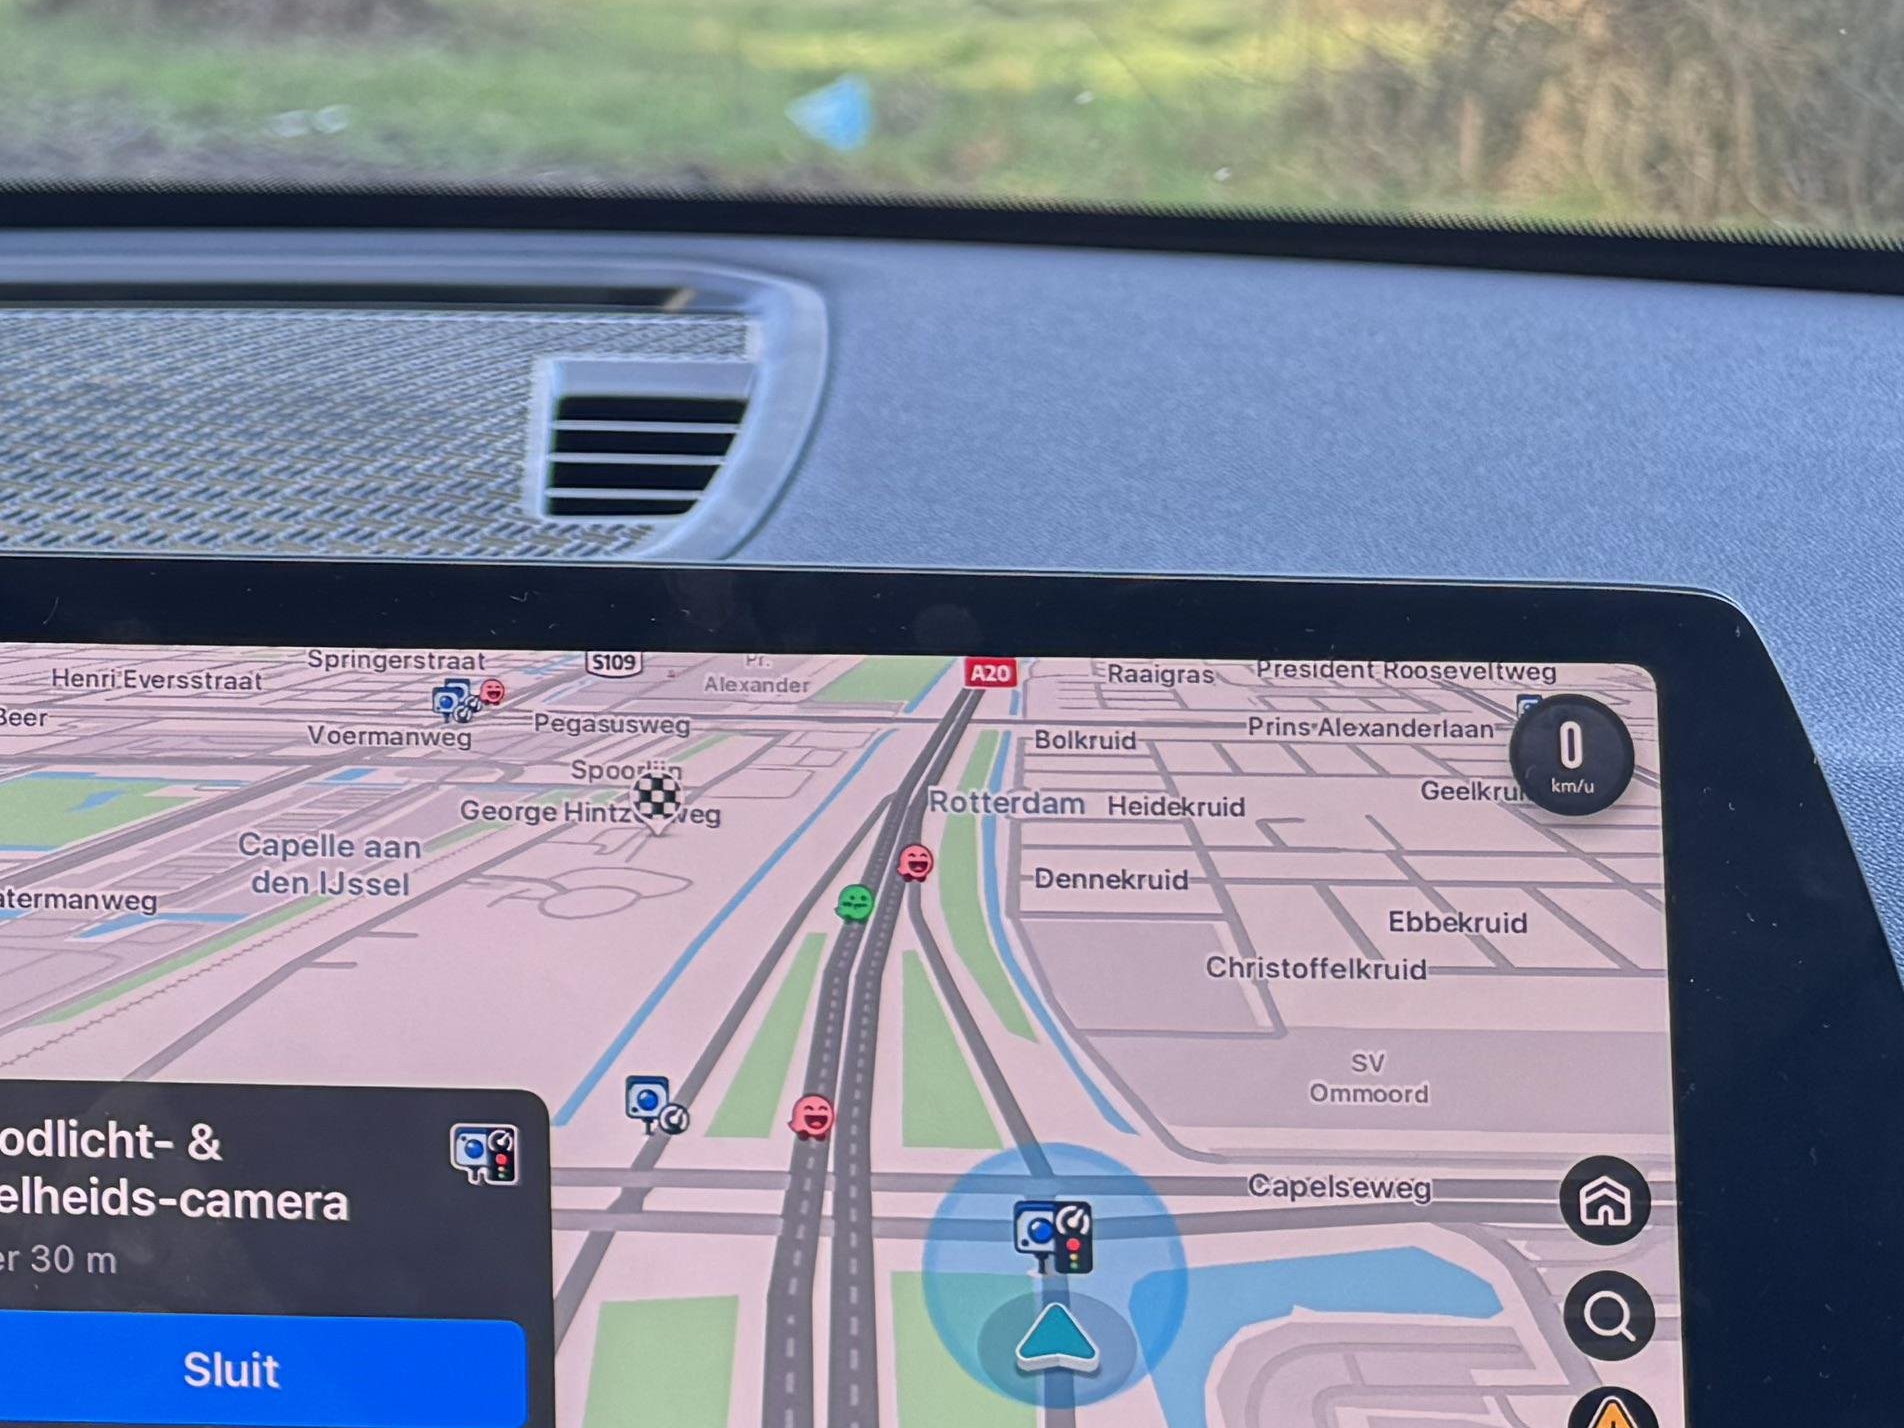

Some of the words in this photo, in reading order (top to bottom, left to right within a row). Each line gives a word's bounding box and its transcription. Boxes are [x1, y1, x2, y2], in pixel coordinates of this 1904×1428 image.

[308, 650, 486, 674] Springerstraat
[592, 654, 636, 671] S109
[971, 664, 1011, 682] A20
[1257, 660, 1375, 679] President
[1383, 661, 1558, 685] Rooseveltweg
[52, 669, 116, 689] Henri
[122, 670, 263, 691] Eversstraat
[704, 676, 811, 693] Alexander
[1108, 664, 1214, 686] Raaigras
[534, 713, 690, 737] Pegasusweg
[1248, 717, 1311, 736] Prins
[1319, 718, 1494, 739] Alexanderlaan
[308, 725, 472, 751] Voermanweg
[1035, 731, 1137, 750] Bolkruid
[1559, 721, 1583, 769] 0
[1551, 779, 1595, 794] km/u
[460, 801, 557, 823] George
[929, 790, 1086, 815] Rotterdam
[1108, 795, 1246, 817] Heidekruid
[239, 832, 358, 861] Capelle
[365, 839, 421, 859] aan
[251, 871, 310, 895] den
[319, 873, 410, 896] IJssel
[1035, 868, 1189, 890] Dennekruid
[1389, 911, 1527, 933] Ebbekruid
[1206, 957, 1427, 980] Christoffelkruid
[1351, 1054, 1385, 1072] SV
[1310, 1084, 1429, 1104] Ommoord
[188, 1124, 223, 1161] &
[1248, 1173, 1432, 1204] Capelseweg
[31, 1244, 73, 1273] 30
[87, 1251, 117, 1274] m
[183, 1351, 281, 1388] Sluit
